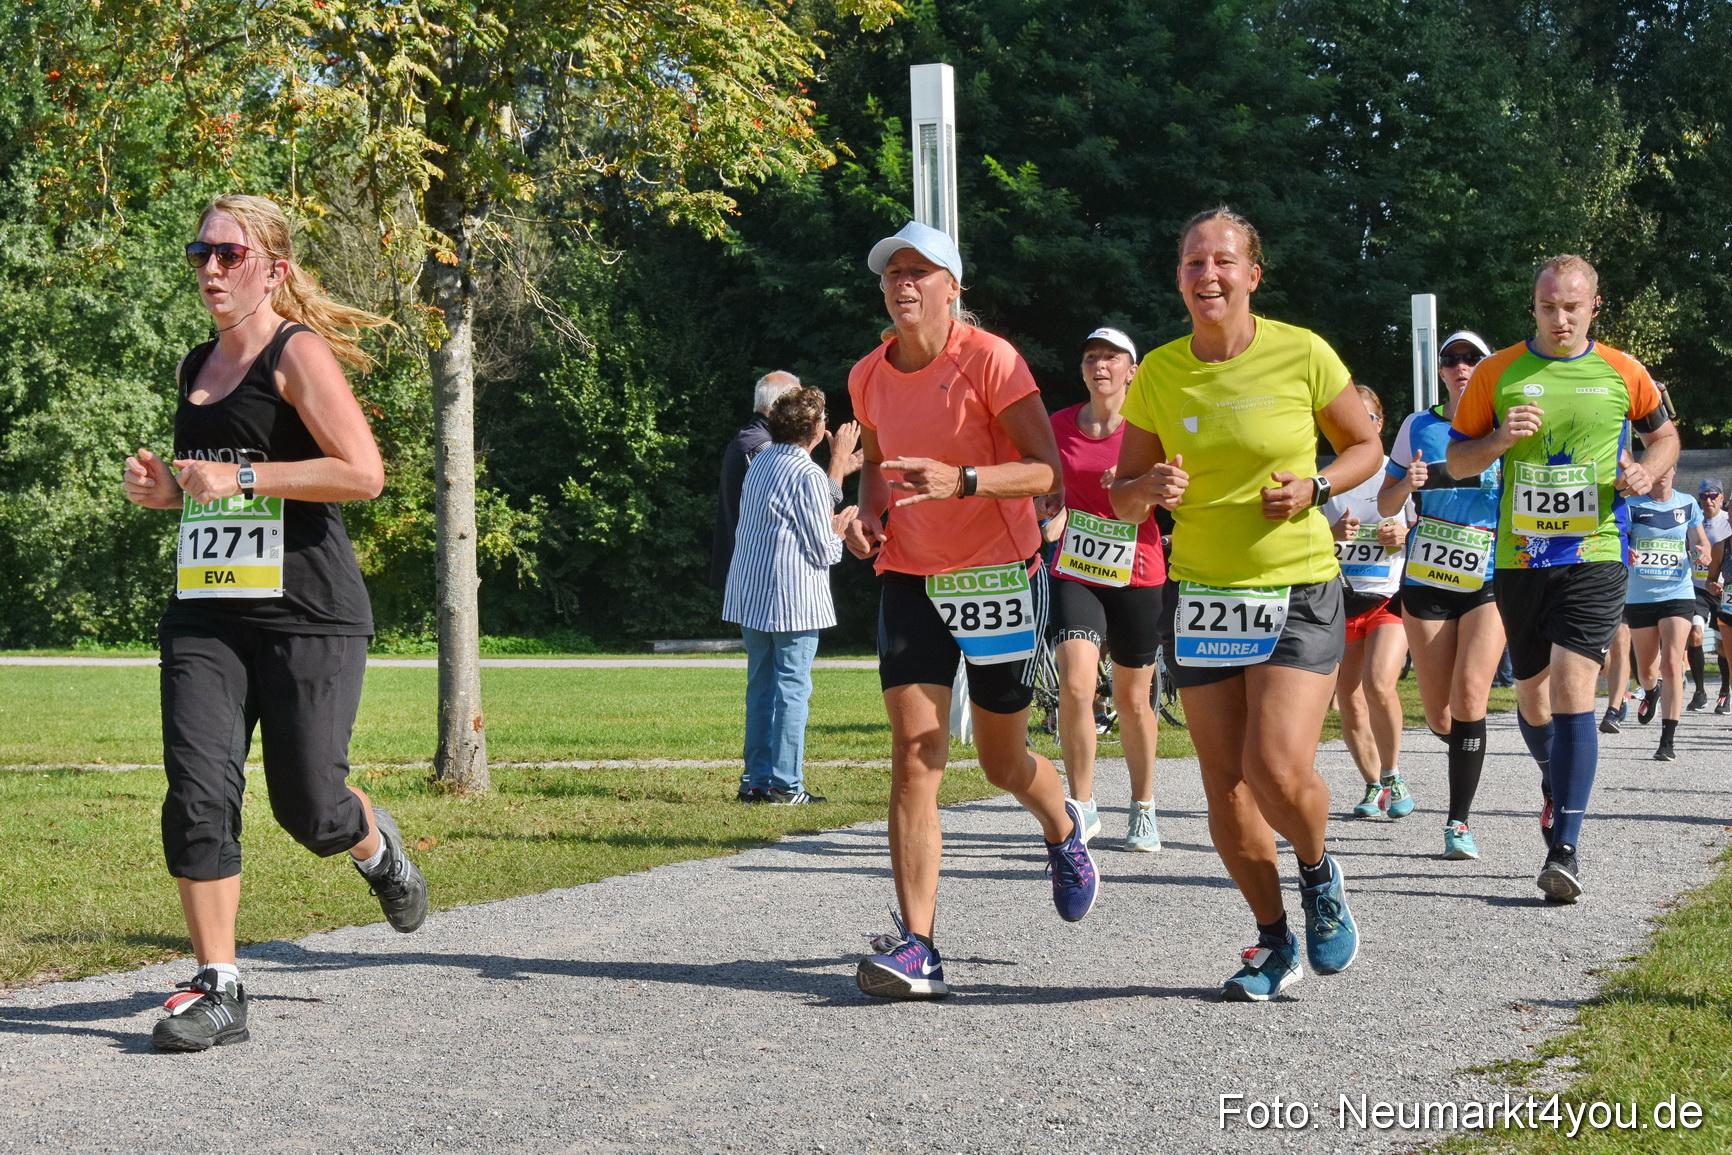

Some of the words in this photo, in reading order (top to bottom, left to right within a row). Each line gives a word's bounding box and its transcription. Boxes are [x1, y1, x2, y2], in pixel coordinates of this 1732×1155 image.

[1520, 466, 1589, 486] BOCK
[1522, 490, 1585, 513] 1281
[1073, 512, 1131, 540] BOCK
[1421, 521, 1487, 548] BOCK
[1536, 521, 1570, 530] RALF
[188, 526, 264, 560] 1271
[1072, 534, 1126, 563] 1077
[1334, 543, 1385, 562] 2797
[1640, 540, 1679, 551] BOCK
[1421, 542, 1479, 571] 1269
[1640, 553, 1679, 567] 2269
[204, 570, 236, 584] EVA
[1069, 558, 1118, 579] MARTINA
[1427, 570, 1460, 584] ANNA
[934, 567, 1024, 594] BOCK
[940, 598, 1024, 632] 2833
[1188, 601, 1274, 633] 2214
[1195, 642, 1259, 655] ANDREA
